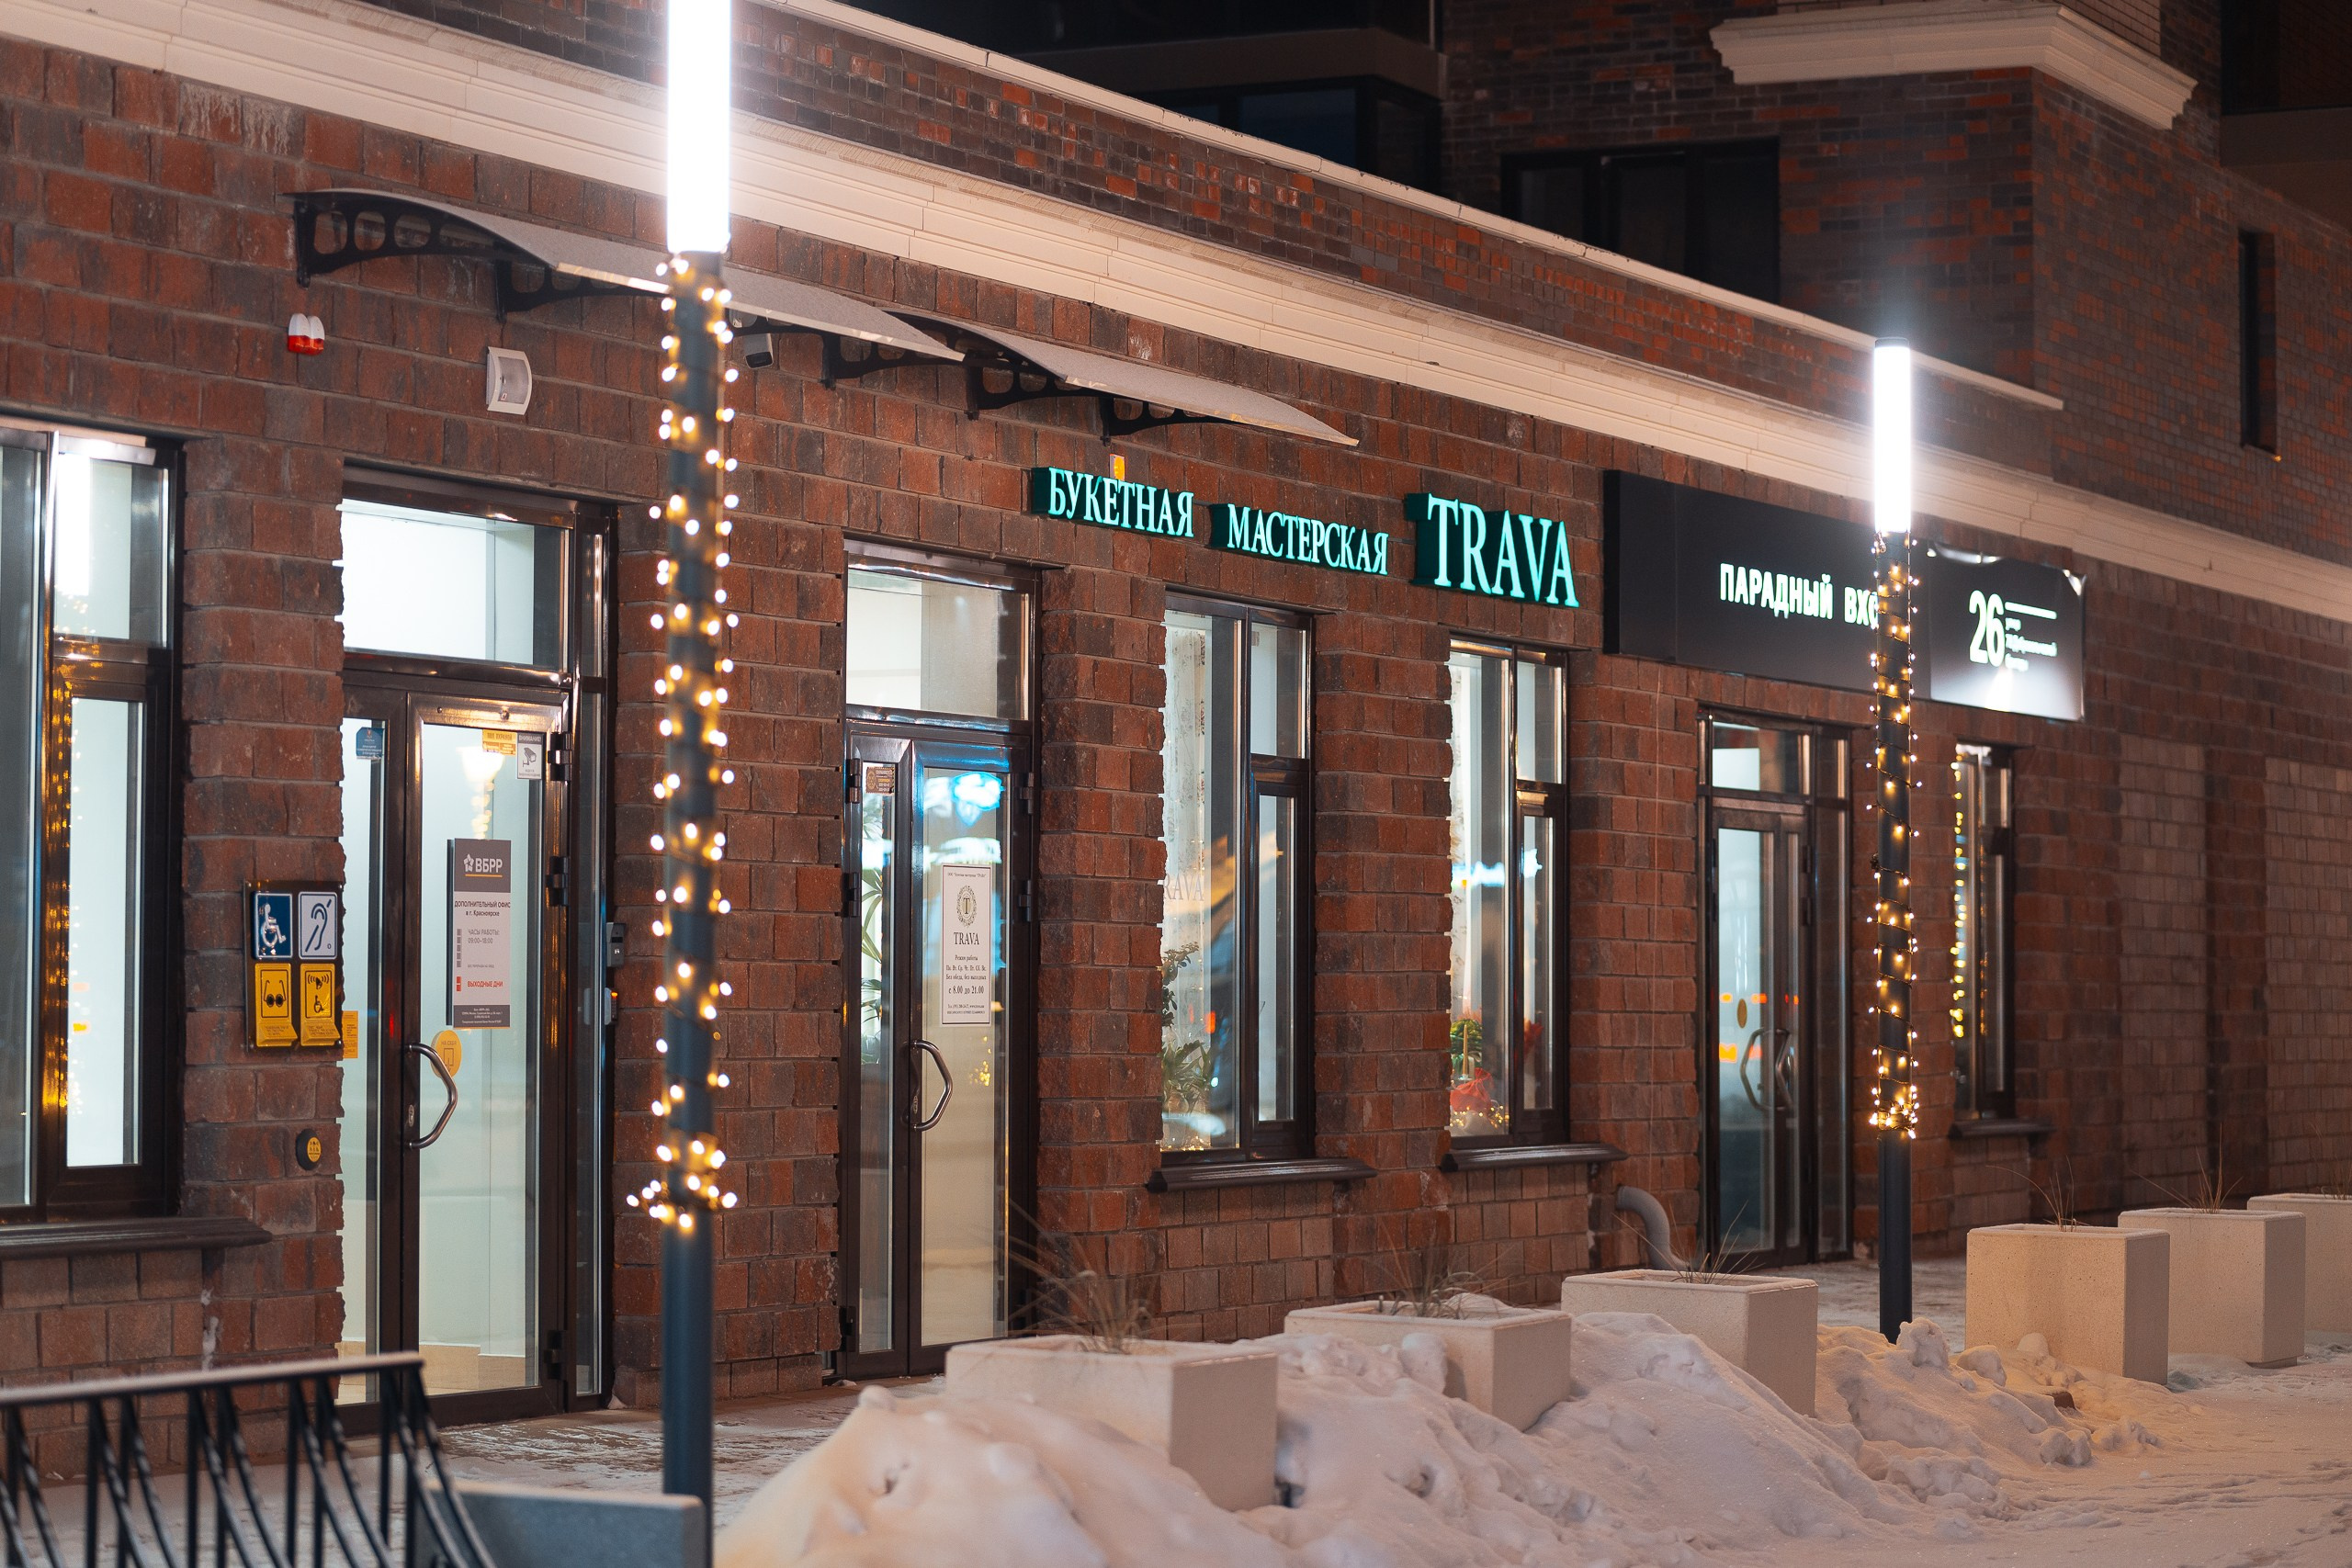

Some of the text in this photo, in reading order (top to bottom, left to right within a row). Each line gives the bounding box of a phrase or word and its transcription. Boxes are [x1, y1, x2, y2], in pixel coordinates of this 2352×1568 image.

[1048, 467, 1389, 576] БУКЕТНАЯ МАСТЕРСКАЯ
[1427, 496, 1580, 608] TRAVA
[1719, 562, 1879, 628] ПАРАДНЫЙ ВХО
[1968, 589, 2006, 668] 26
[474, 857, 503, 874] ВБРР
[1164, 873, 1204, 902] RAVA
[454, 900, 497, 908] ДОПОЛНИТЕЛЬНЫЙ
[954, 932, 979, 945] TRAVA
